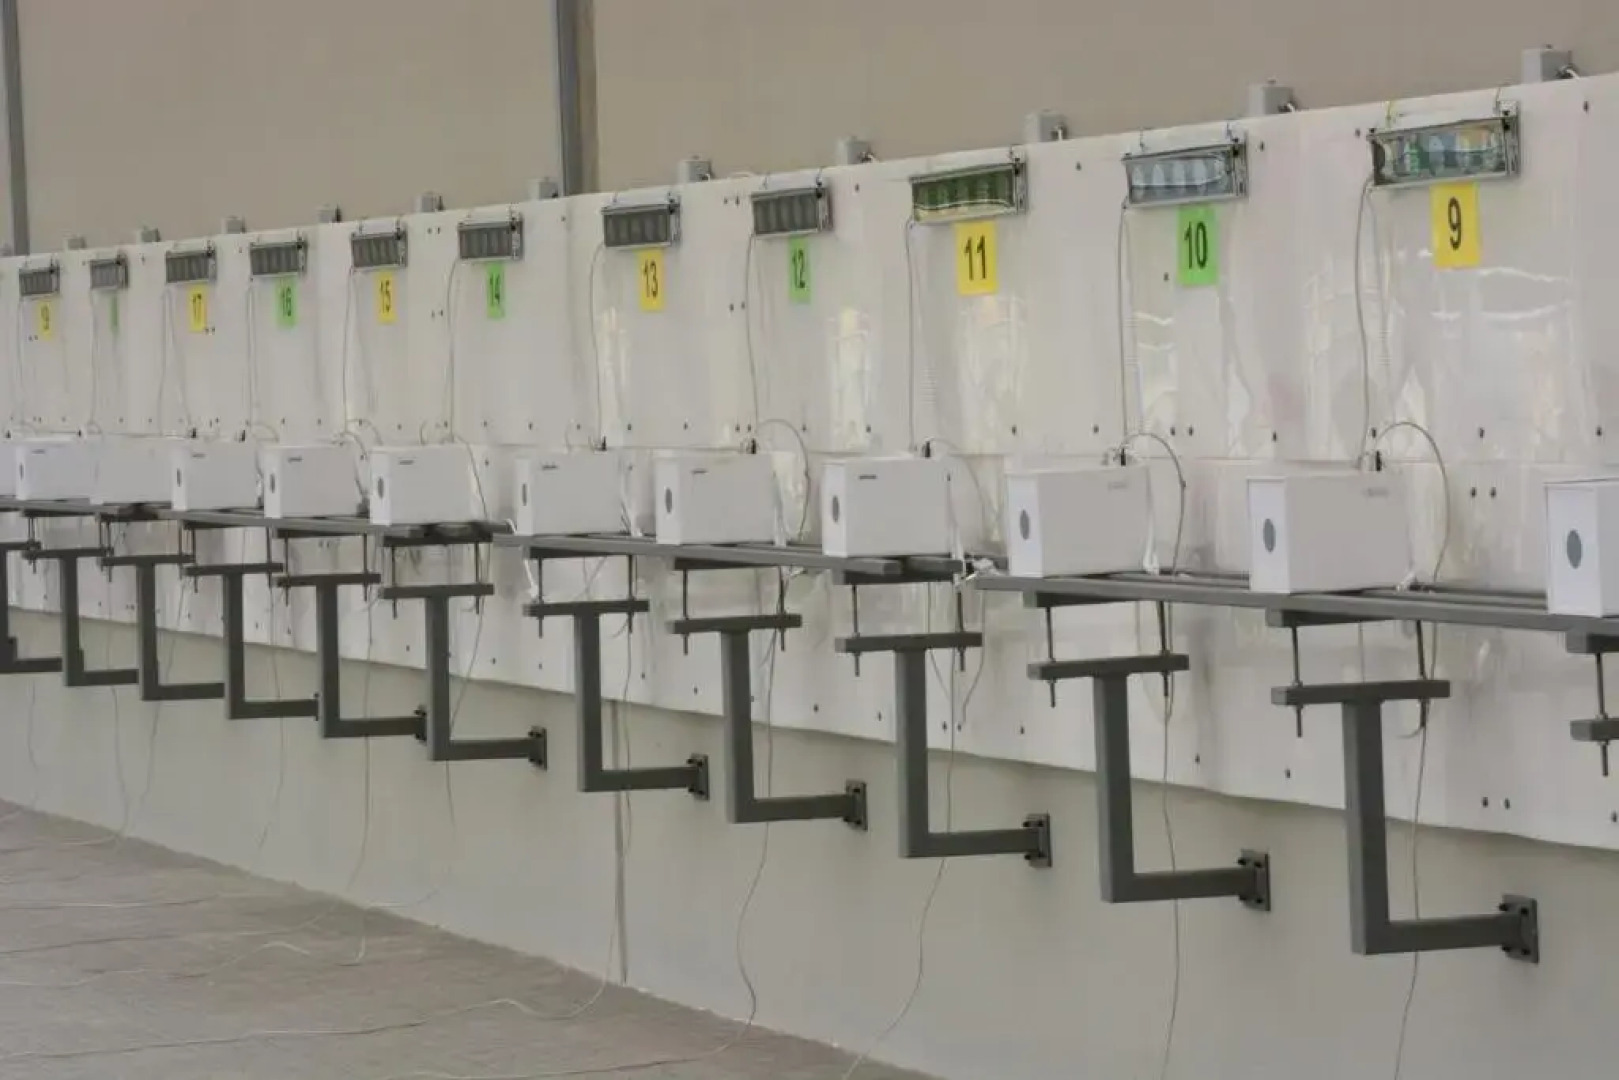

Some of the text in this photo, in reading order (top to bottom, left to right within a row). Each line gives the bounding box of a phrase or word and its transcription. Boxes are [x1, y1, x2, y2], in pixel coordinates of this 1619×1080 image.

[1447, 196, 1462, 250] 9
[963, 235, 985, 281] 11
[1184, 221, 1208, 269] 10
[643, 260, 659, 298] 13
[792, 249, 806, 289] 12
[380, 280, 391, 313] 15
[489, 273, 501, 306] 14
